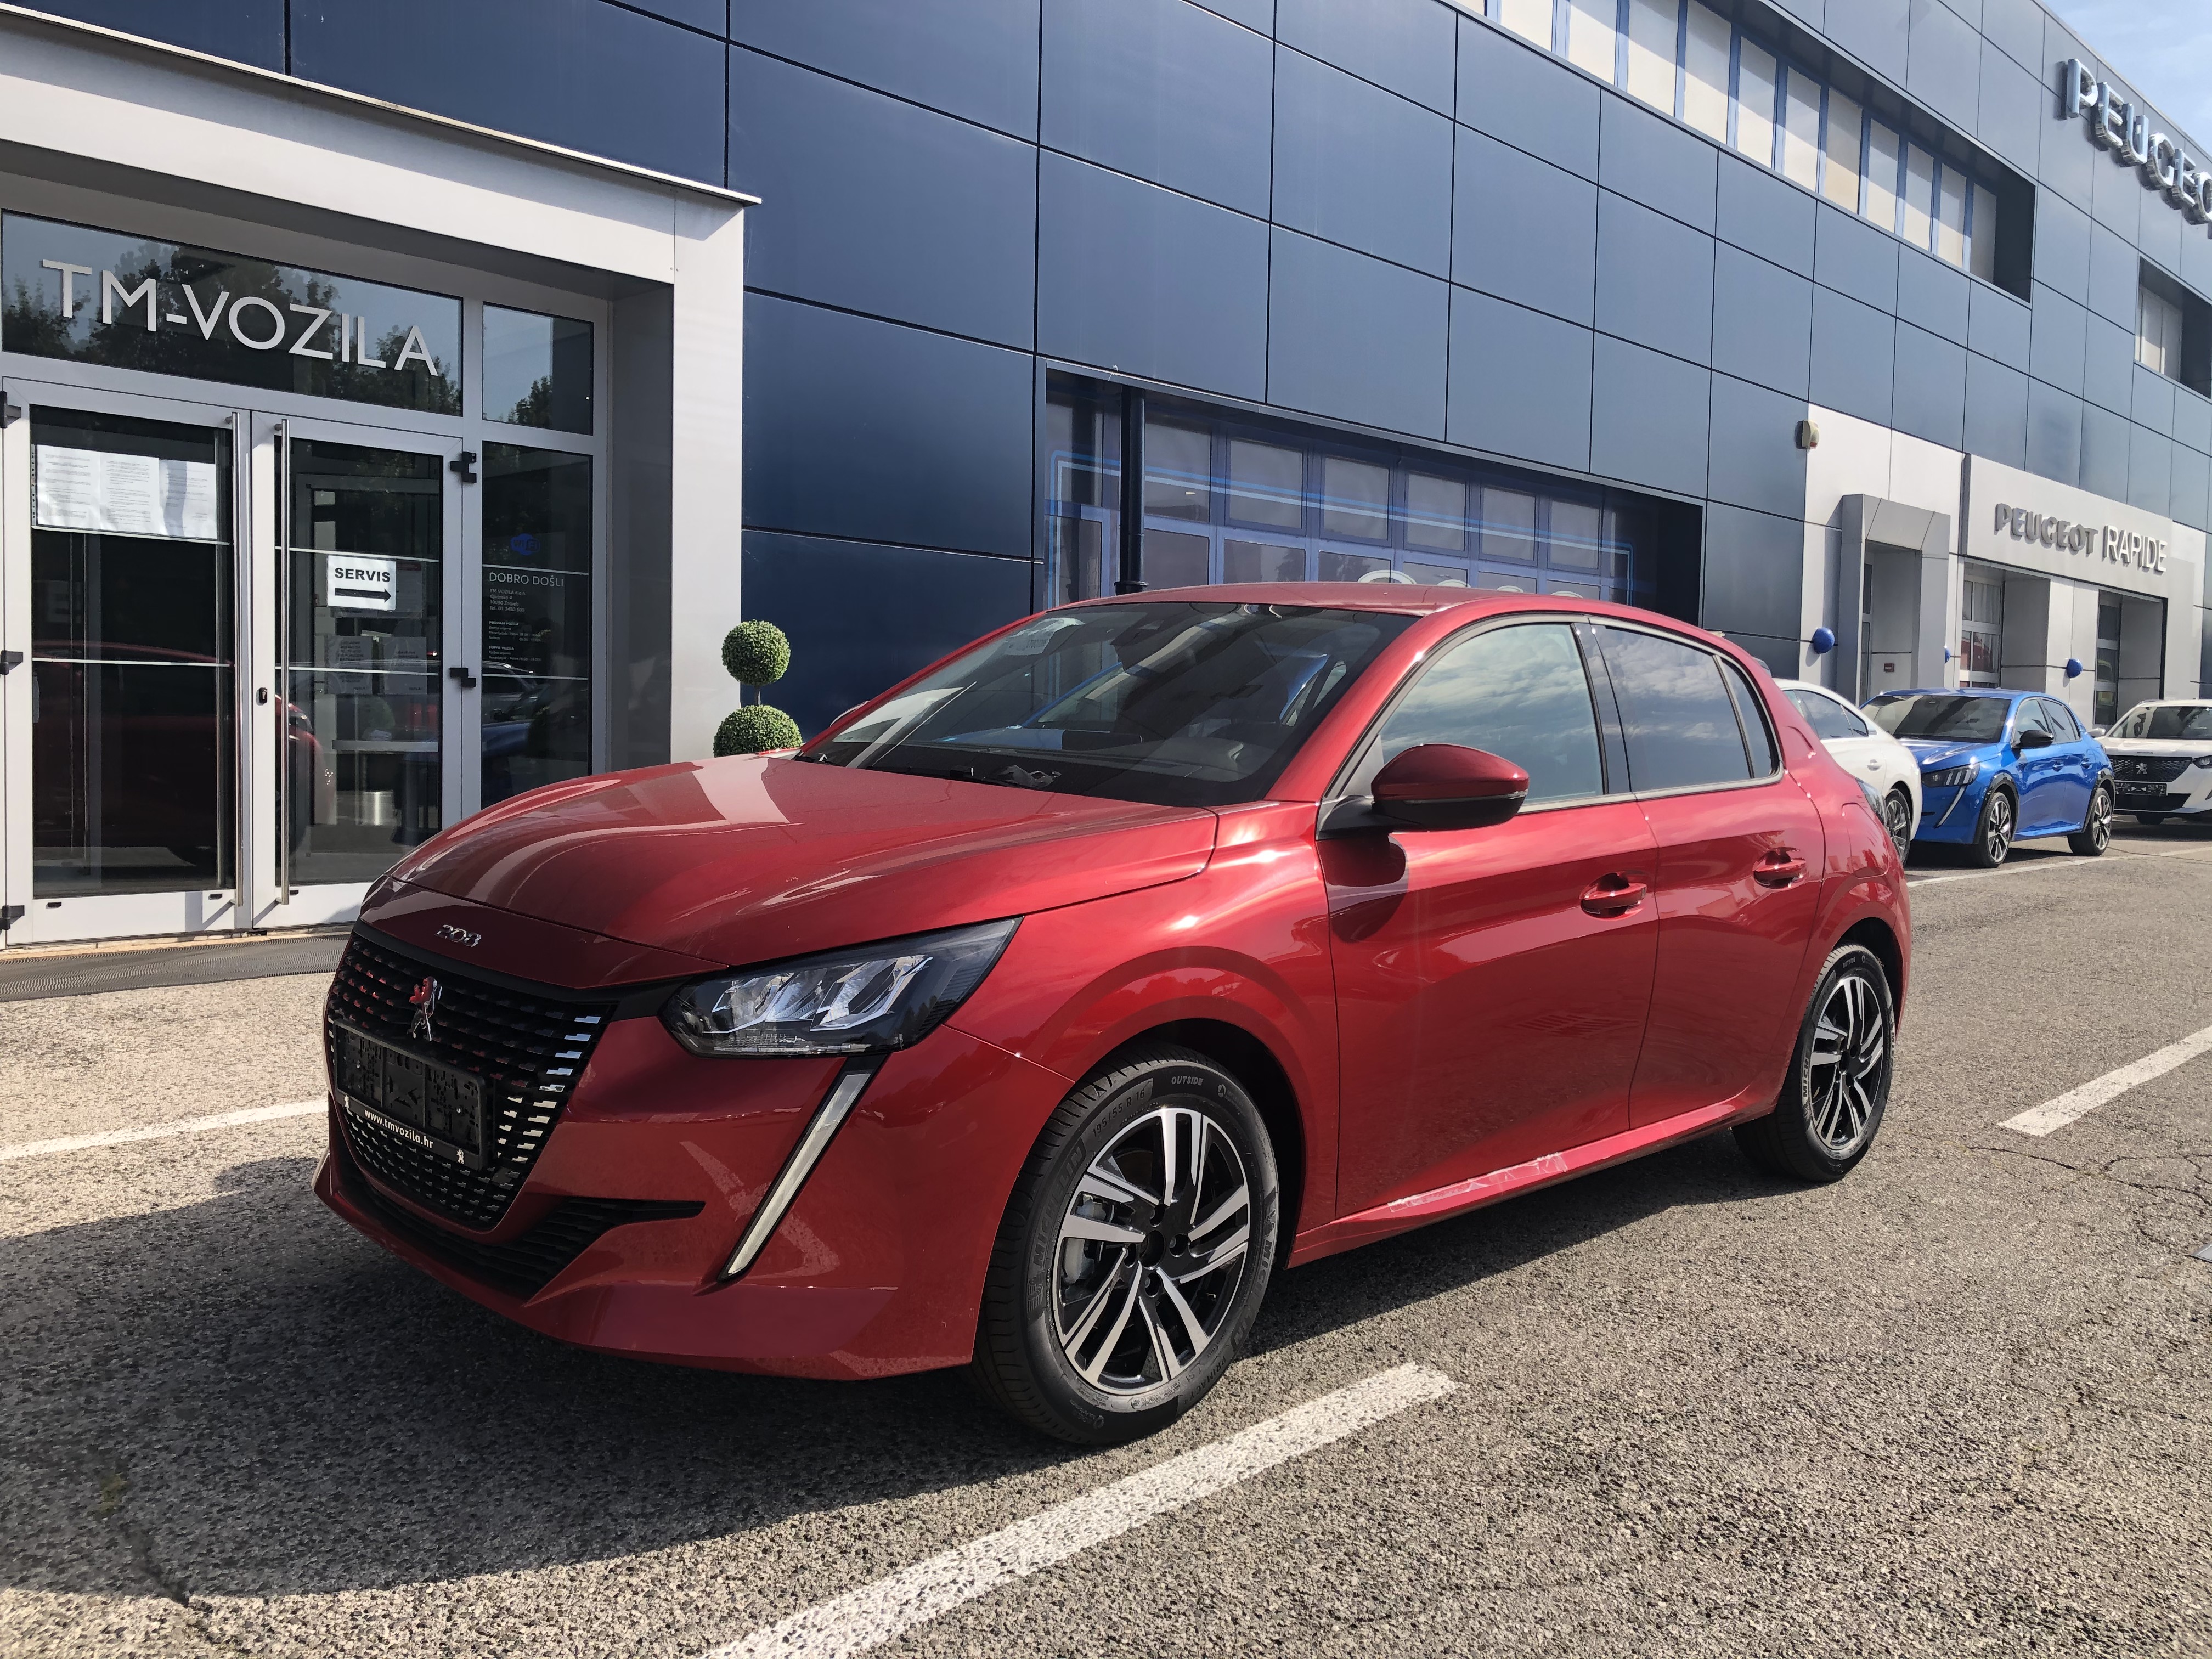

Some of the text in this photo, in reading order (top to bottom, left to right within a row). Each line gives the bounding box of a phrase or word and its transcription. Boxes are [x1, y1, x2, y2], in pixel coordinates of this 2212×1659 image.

[42, 259, 438, 376] TM-VOZILA
[1995, 503, 2168, 572] PEUGEOT RAPIDE
[334, 567, 391, 583] SERVIS
[489, 572, 563, 587] DOBRO DOŠLI
[434, 924, 482, 947] 208
[1171, 1075, 1204, 1086] OUTSIDE
[1092, 1103, 1123, 1137] 195/55
[1126, 1097, 1132, 1107] R
[1136, 1088, 1145, 1101] 16
[364, 1109, 433, 1148] www.tmvozila.hr
